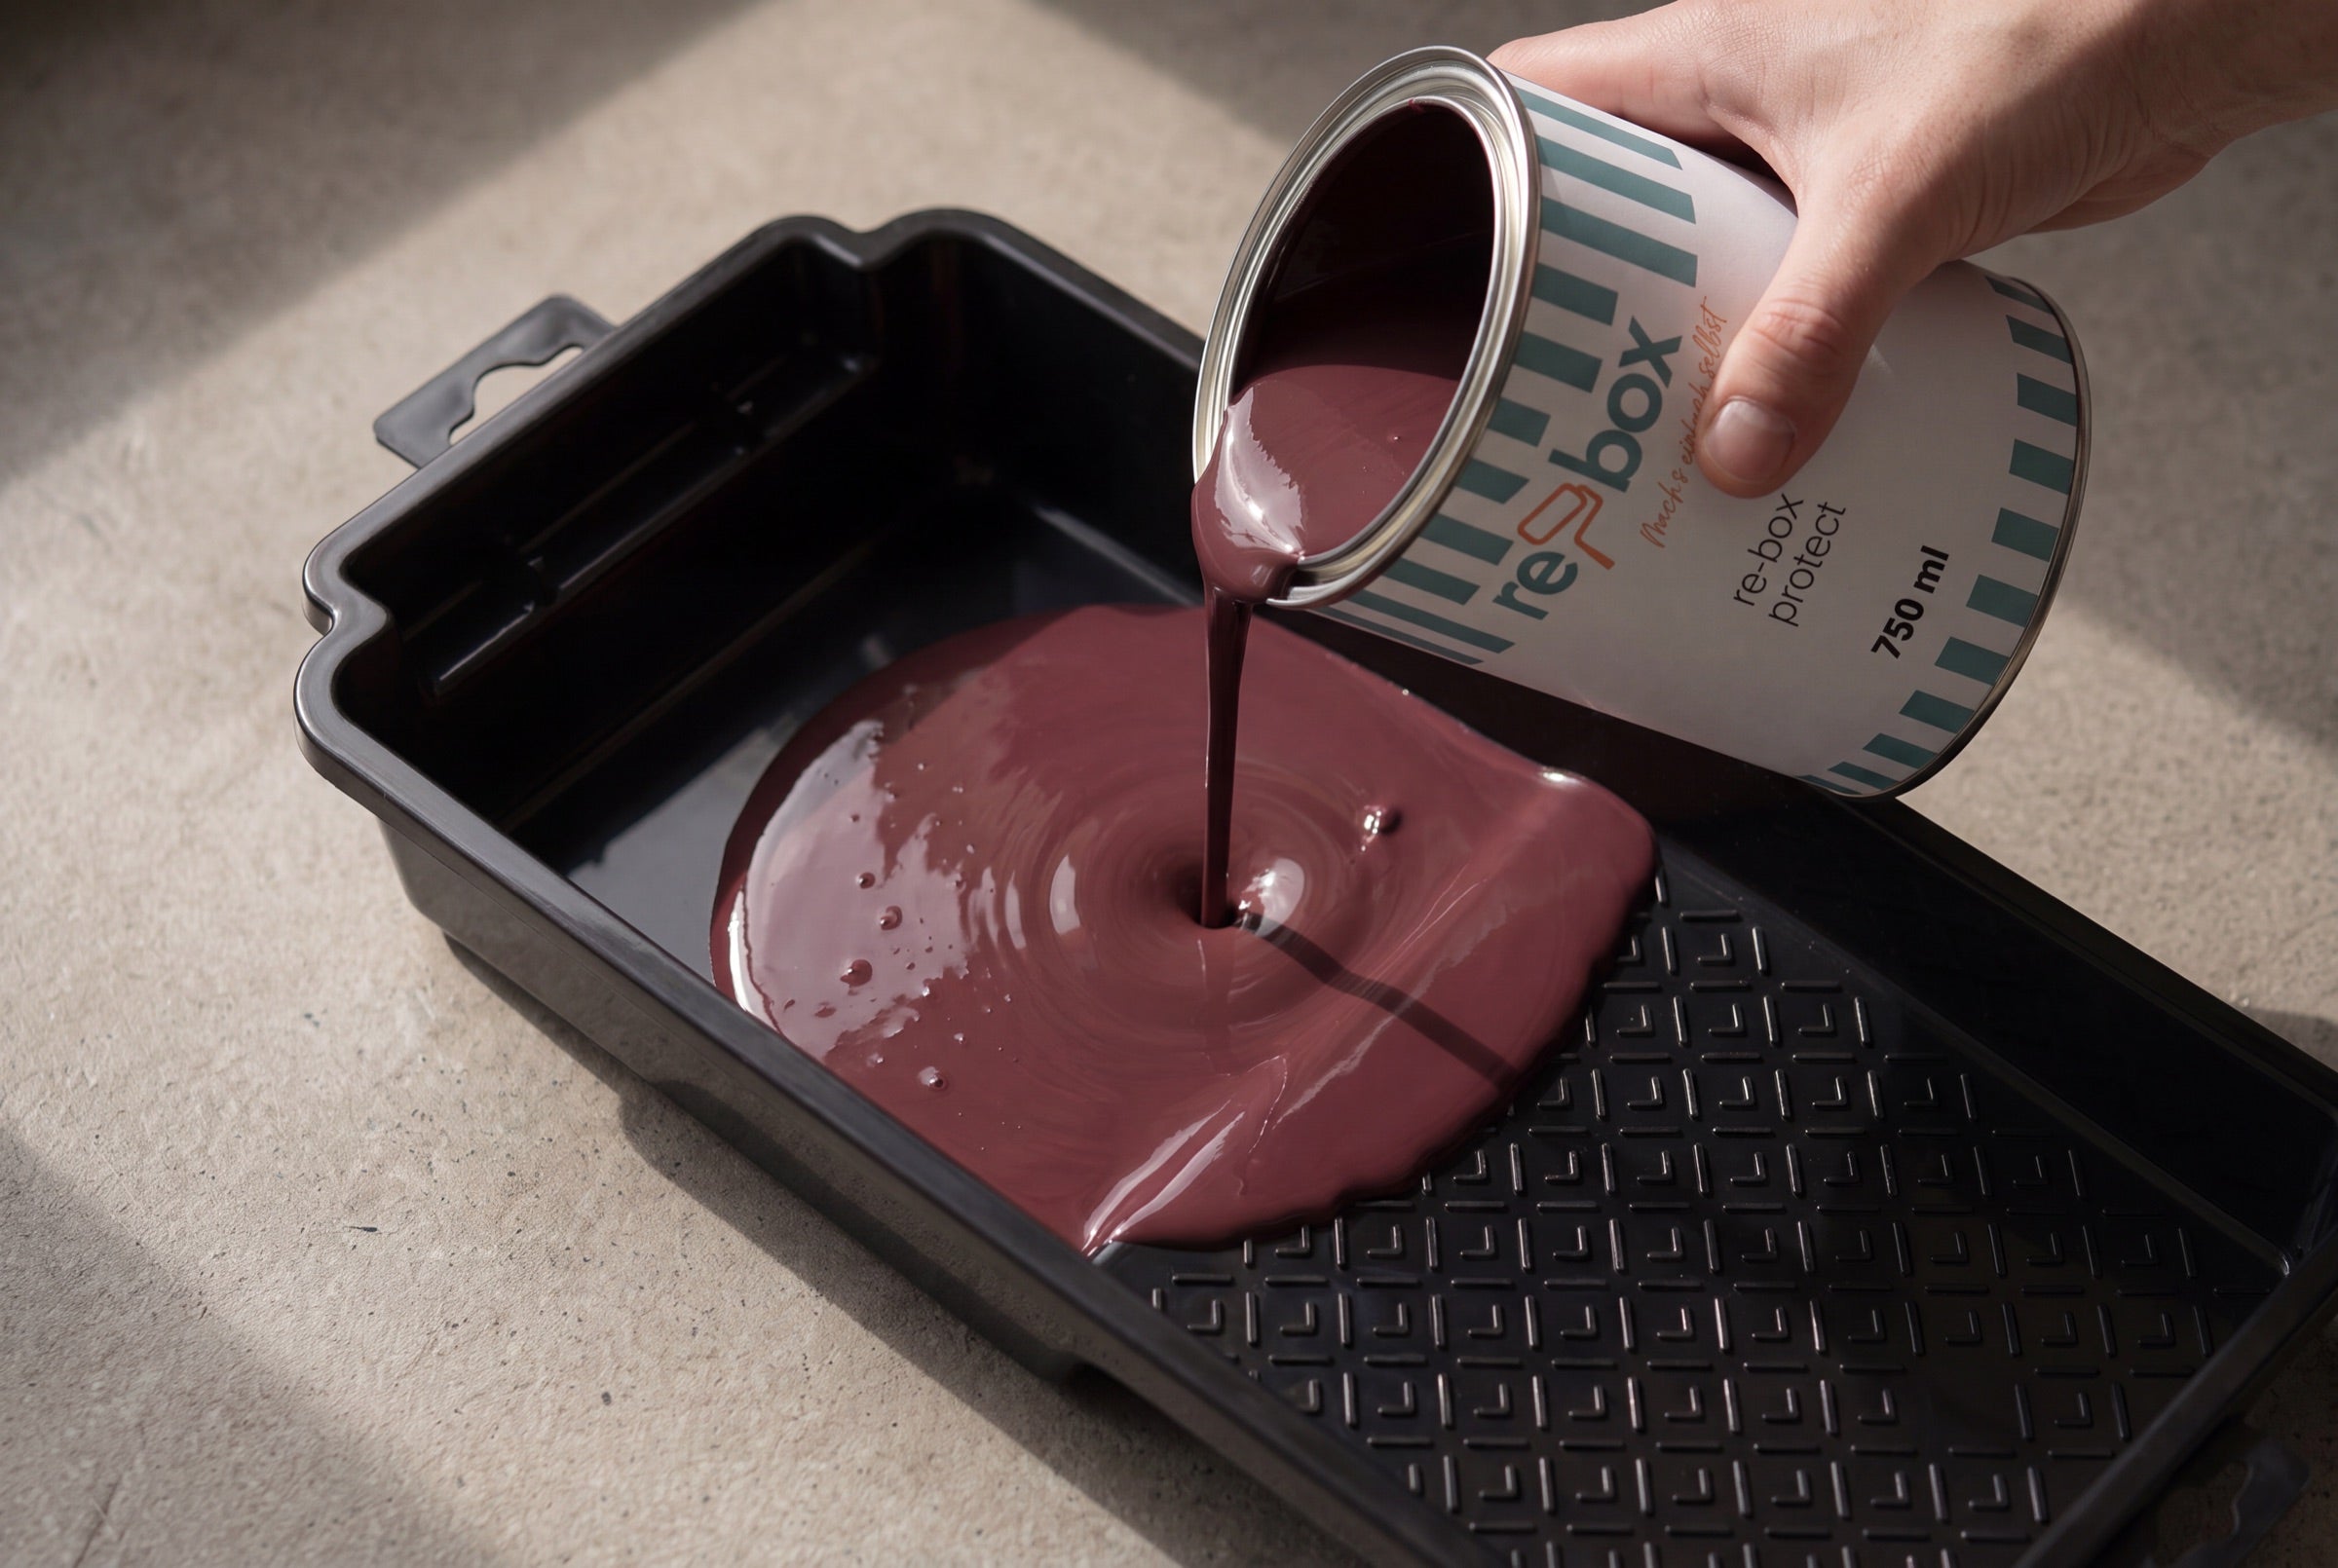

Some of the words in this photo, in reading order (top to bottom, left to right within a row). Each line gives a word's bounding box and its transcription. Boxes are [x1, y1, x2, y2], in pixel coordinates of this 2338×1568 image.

[1692, 295, 1727, 380] selbst
[1492, 550, 1578, 620] re
[1548, 315, 1683, 493] box
[1733, 493, 1804, 607] re-box
[1768, 502, 1847, 627] protect
[1870, 598, 1925, 659] 750
[1913, 544, 1949, 594] ml
